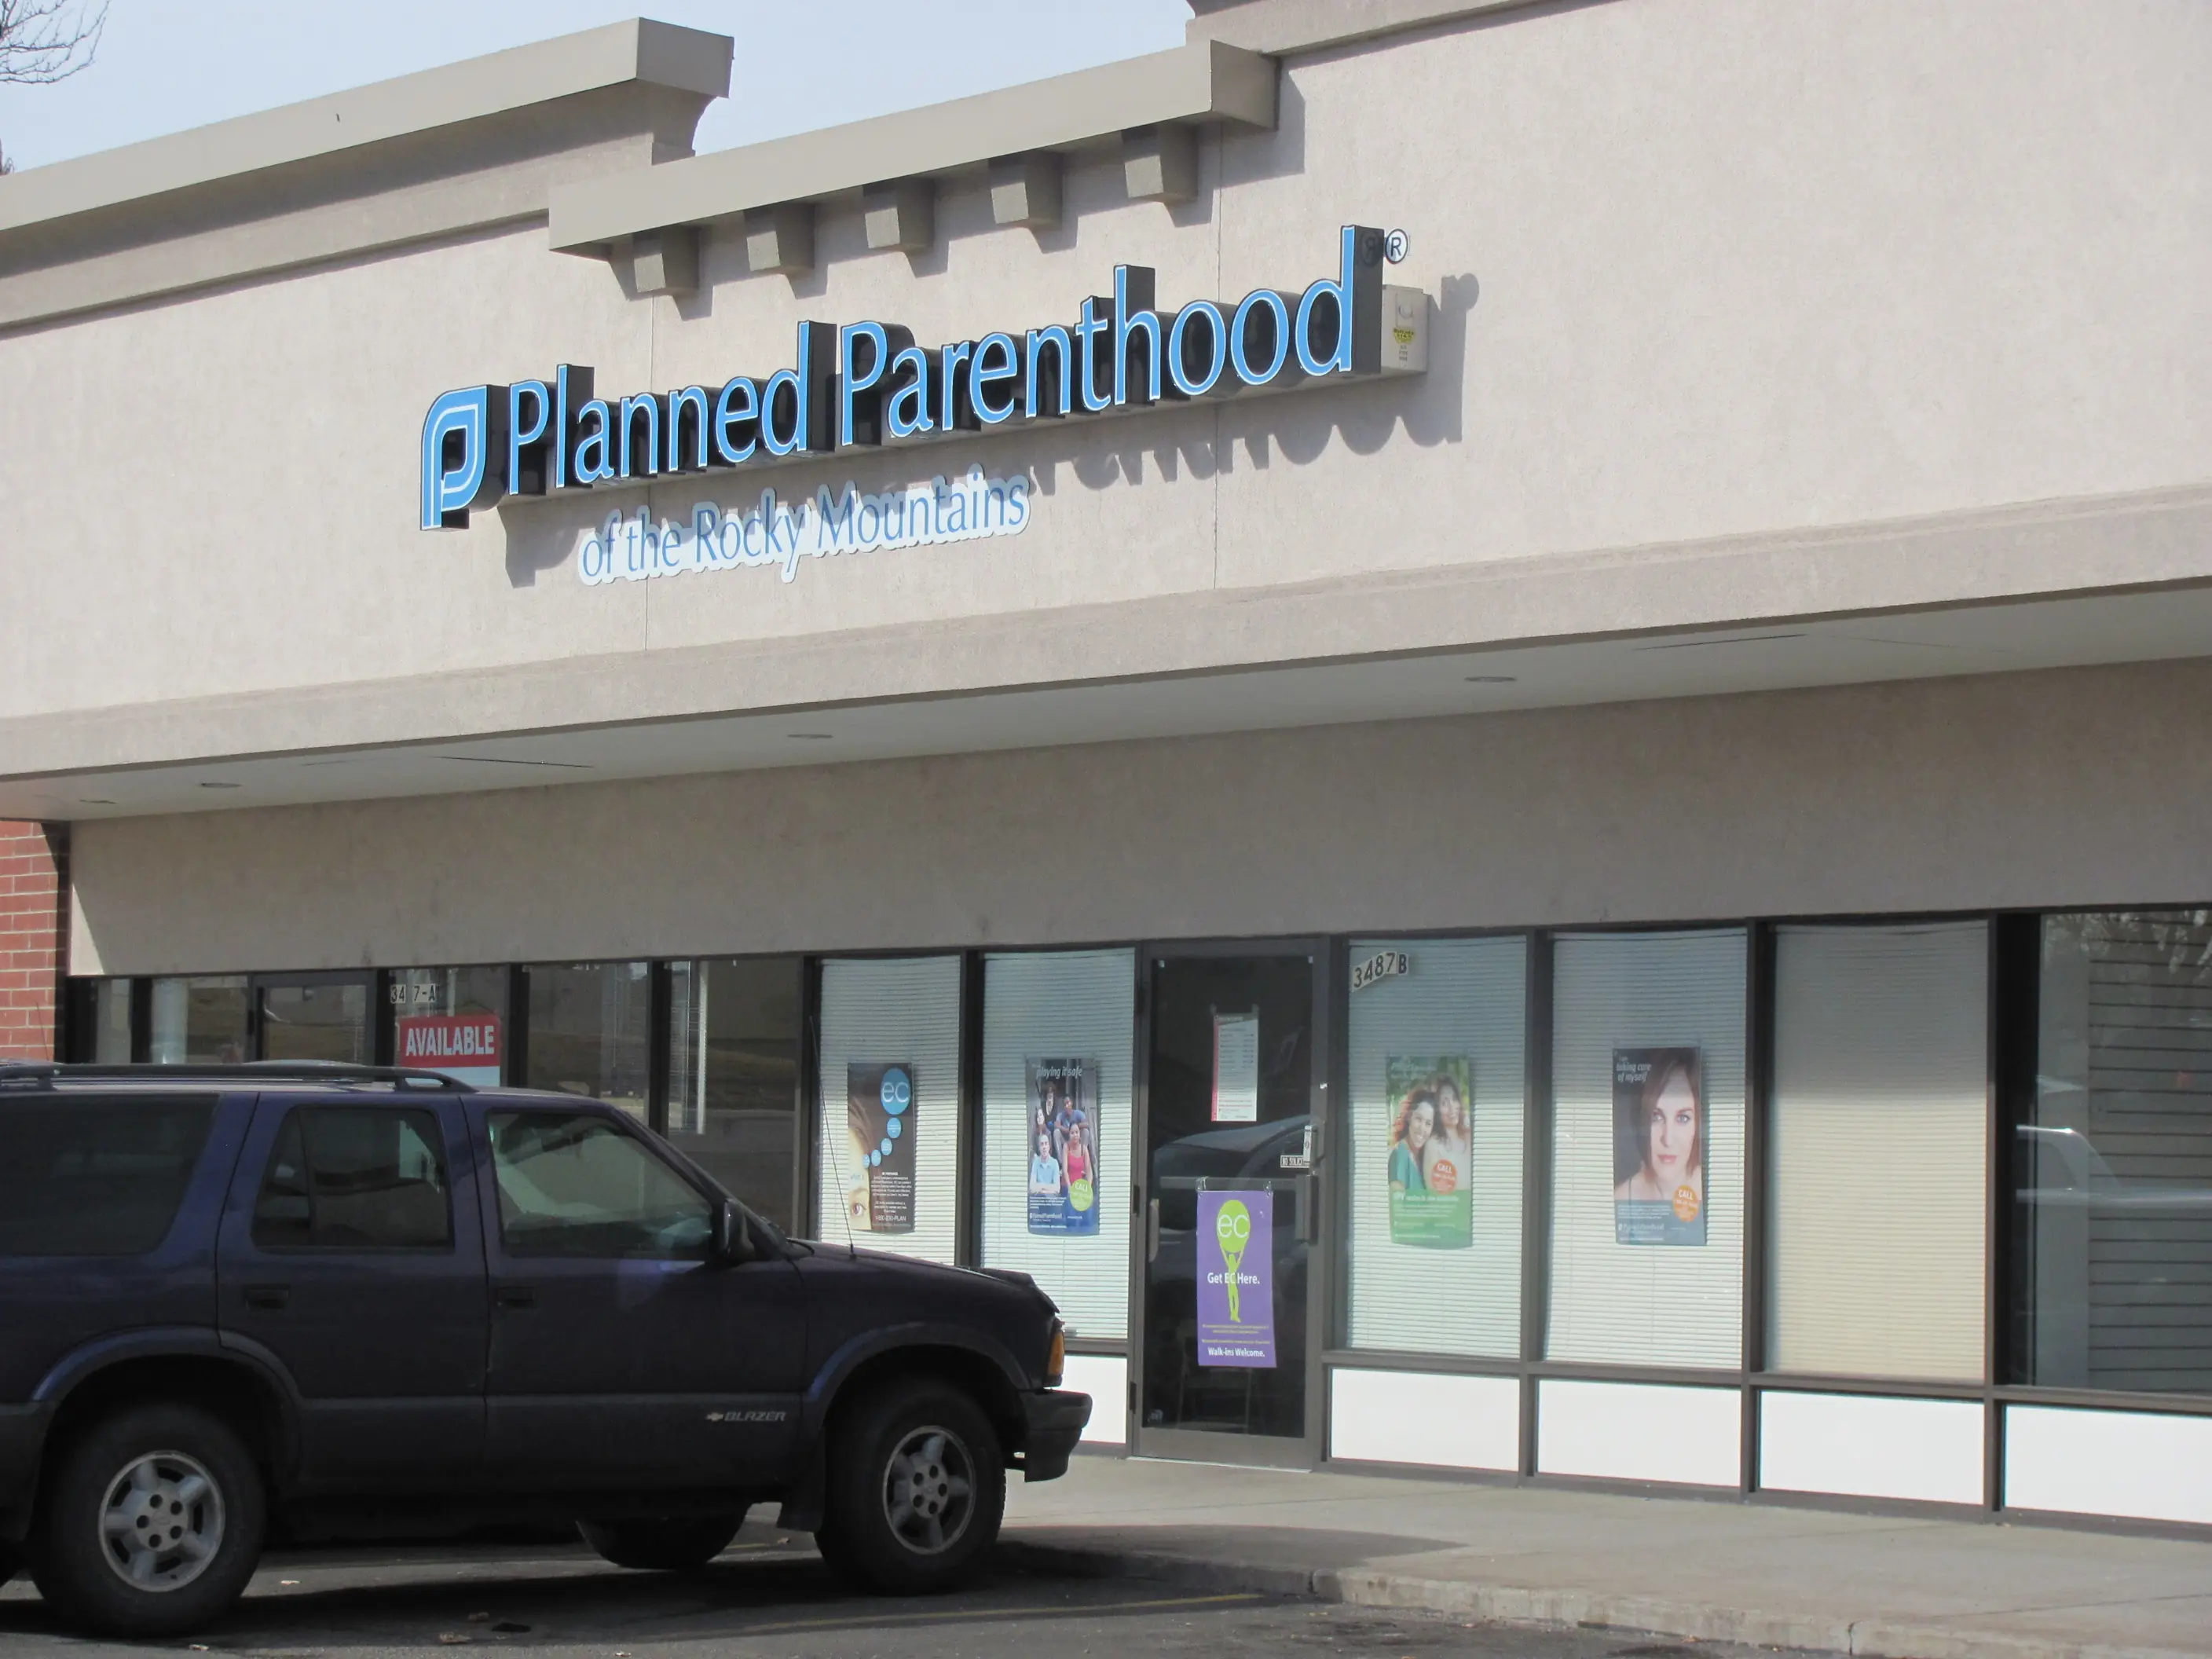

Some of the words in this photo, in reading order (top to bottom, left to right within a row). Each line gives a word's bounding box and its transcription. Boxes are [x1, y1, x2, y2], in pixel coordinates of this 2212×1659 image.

[508, 320, 810, 496] Planned
[840, 225, 1354, 446] Parenthood
[583, 517, 618, 577] of
[627, 513, 680, 568] the
[696, 496, 804, 573] Rocky
[818, 471, 1024, 549] Mountains
[405, 1024, 495, 1057] AVAILABLE
[1068, 1065, 1082, 1079] safe
[881, 1082, 910, 1103] ec
[1218, 1214, 1249, 1239] ec
[1207, 1273, 1223, 1284] Get
[1225, 1273, 1236, 1284] EC
[1237, 1273, 1261, 1285] Here.
[1207, 1346, 1234, 1357] Walk-ins
[724, 1411, 786, 1422] BLAZER
